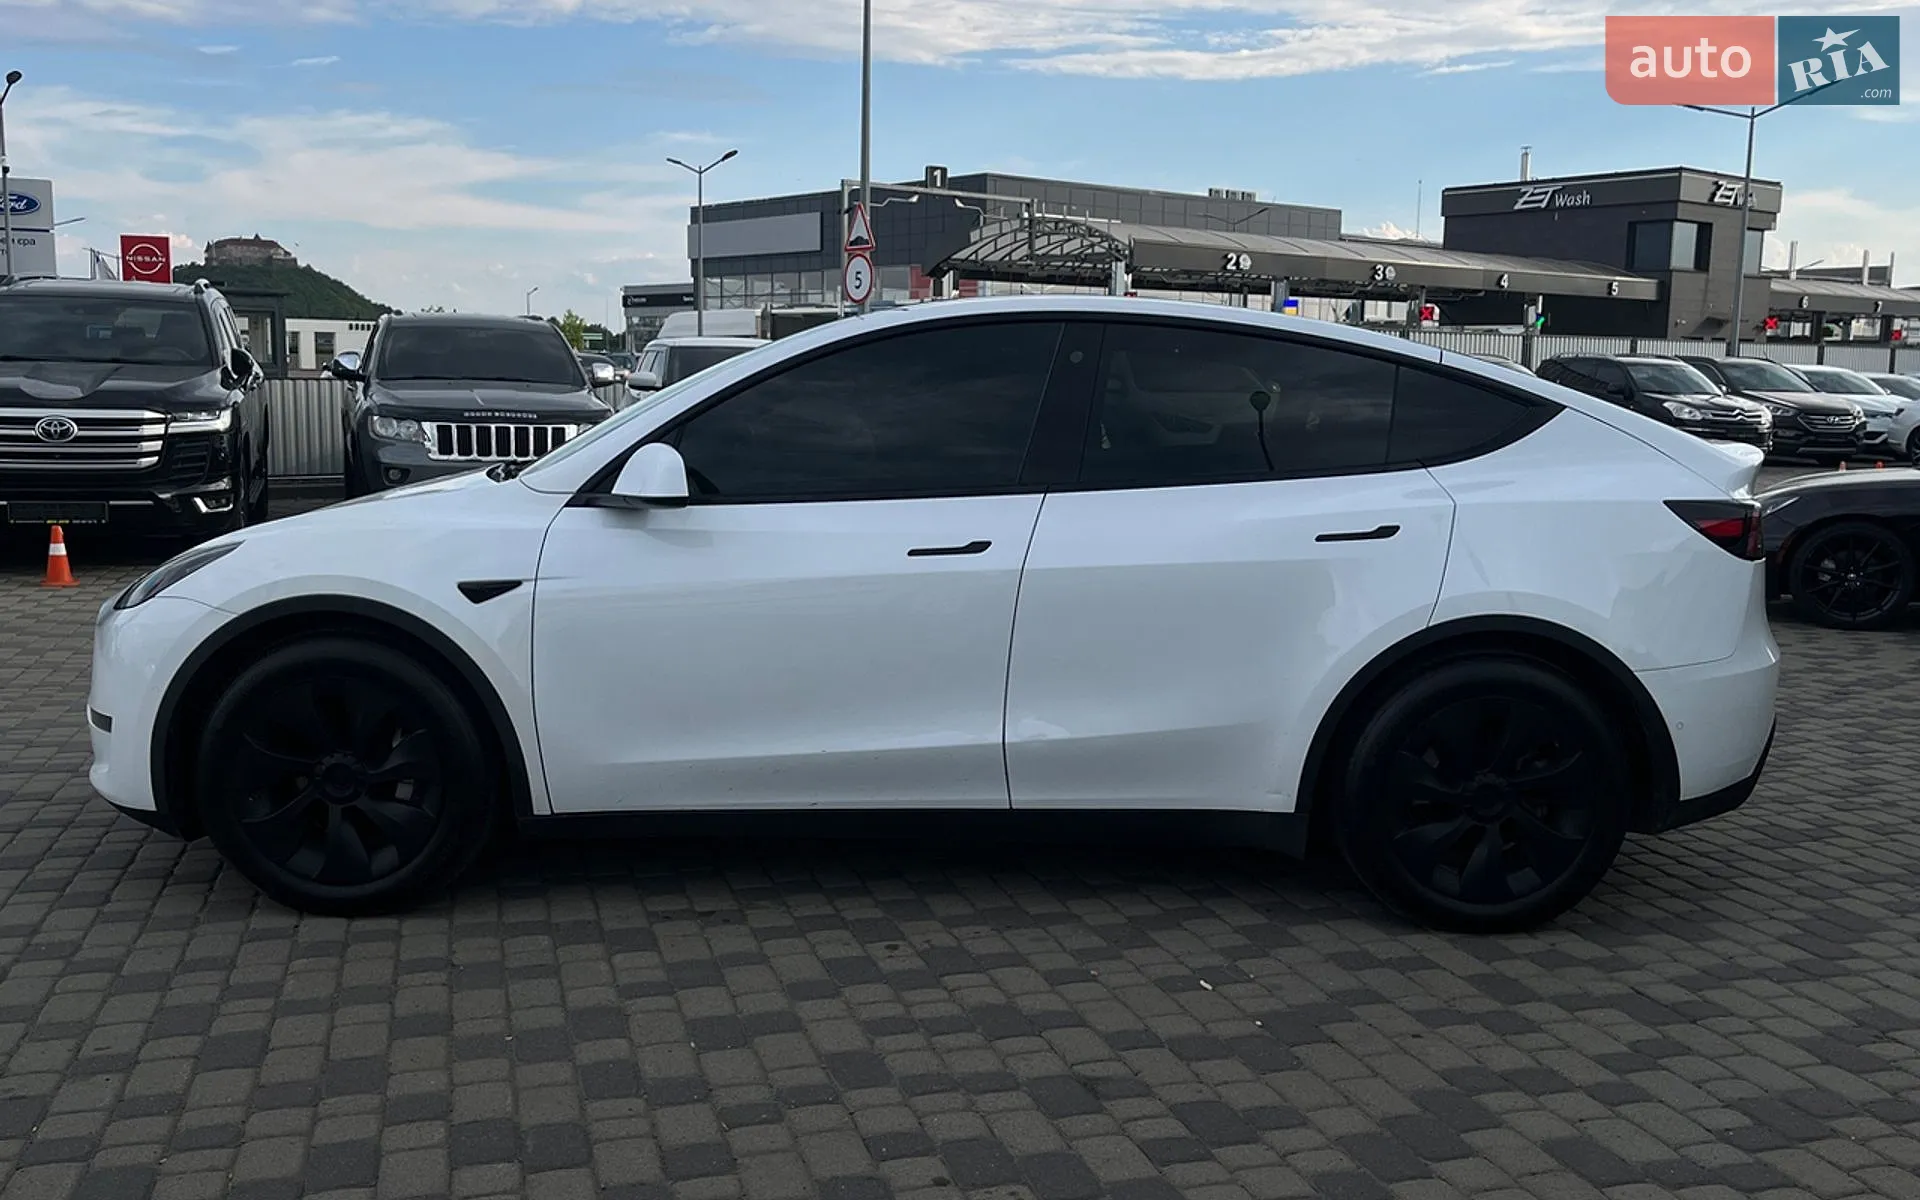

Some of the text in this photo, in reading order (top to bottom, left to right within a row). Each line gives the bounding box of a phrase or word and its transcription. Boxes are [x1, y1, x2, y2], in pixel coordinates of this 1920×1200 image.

[933, 169, 942, 188] 1
[1555, 190, 1591, 208] Wash
[126, 255, 166, 263] NISSAN
[854, 271, 862, 290] 5
[1500, 273, 1509, 289] 4
[1611, 281, 1619, 297] 5
[1802, 295, 1809, 309] 6
